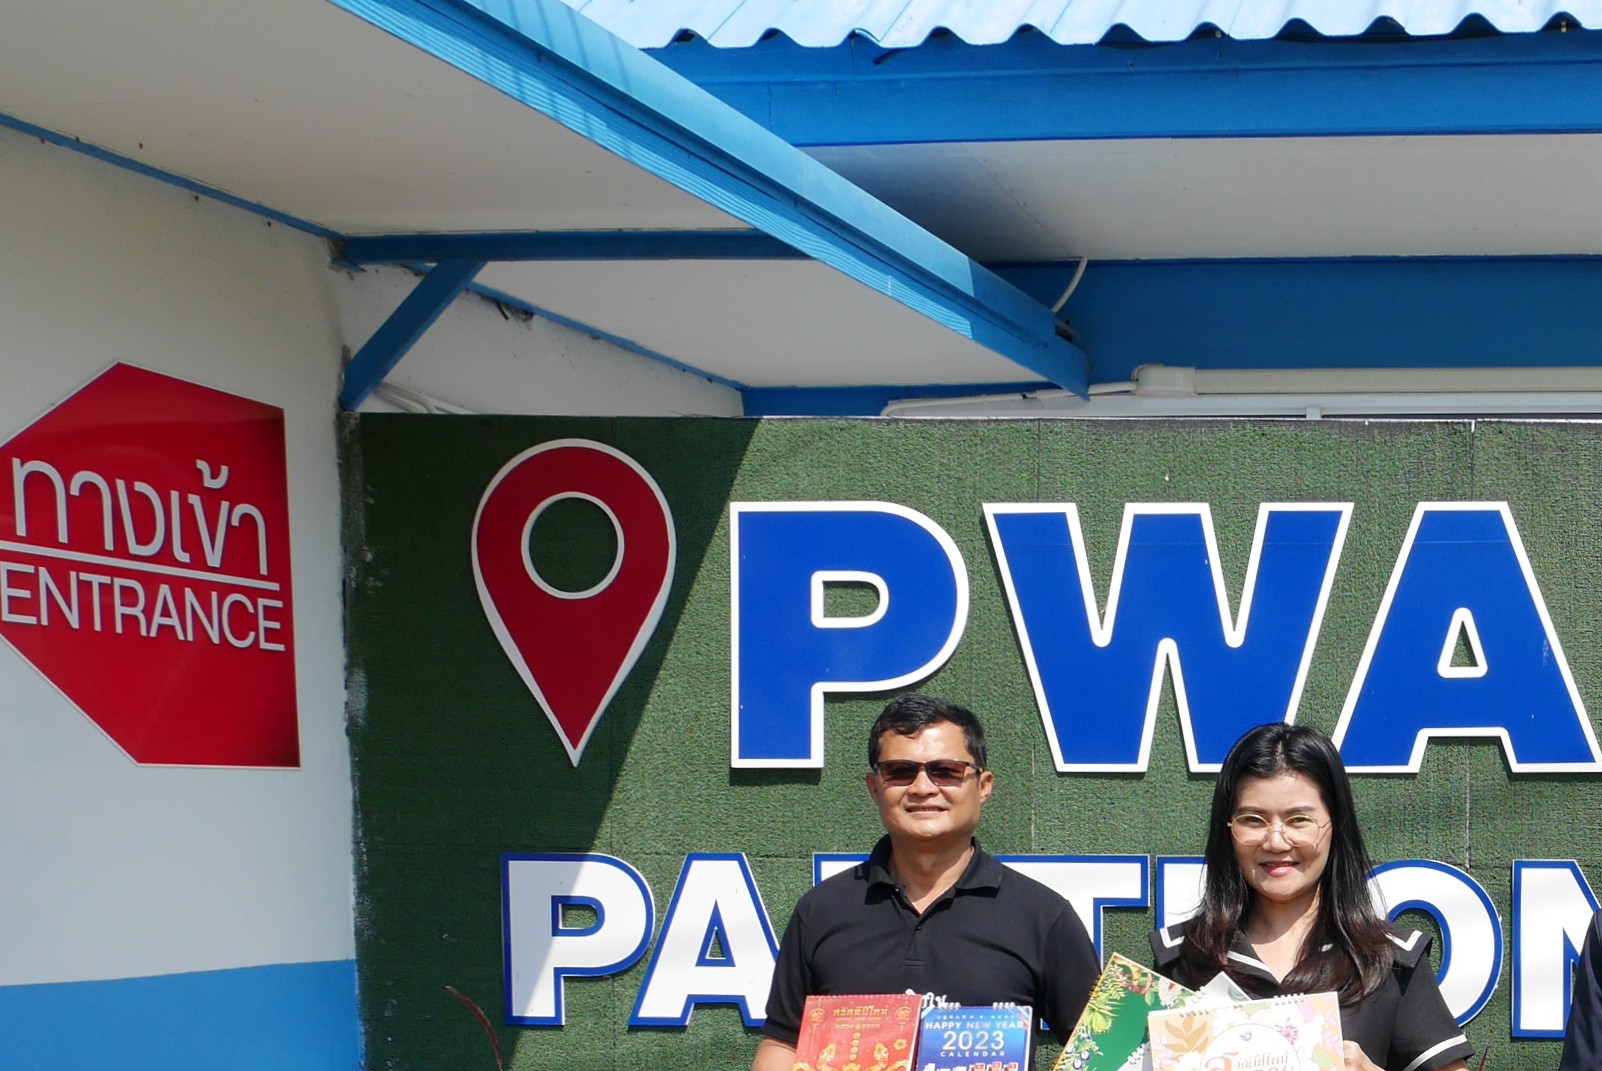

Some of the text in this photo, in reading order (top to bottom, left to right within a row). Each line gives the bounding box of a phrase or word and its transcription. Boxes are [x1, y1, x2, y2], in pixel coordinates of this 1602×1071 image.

[12, 457, 268, 576] ทางเข้า
[0, 561, 286, 652] ENTRANCE
[925, 1021, 1024, 1030] HAPPY NEW YEAR
[942, 1030, 1005, 1051] 2023
